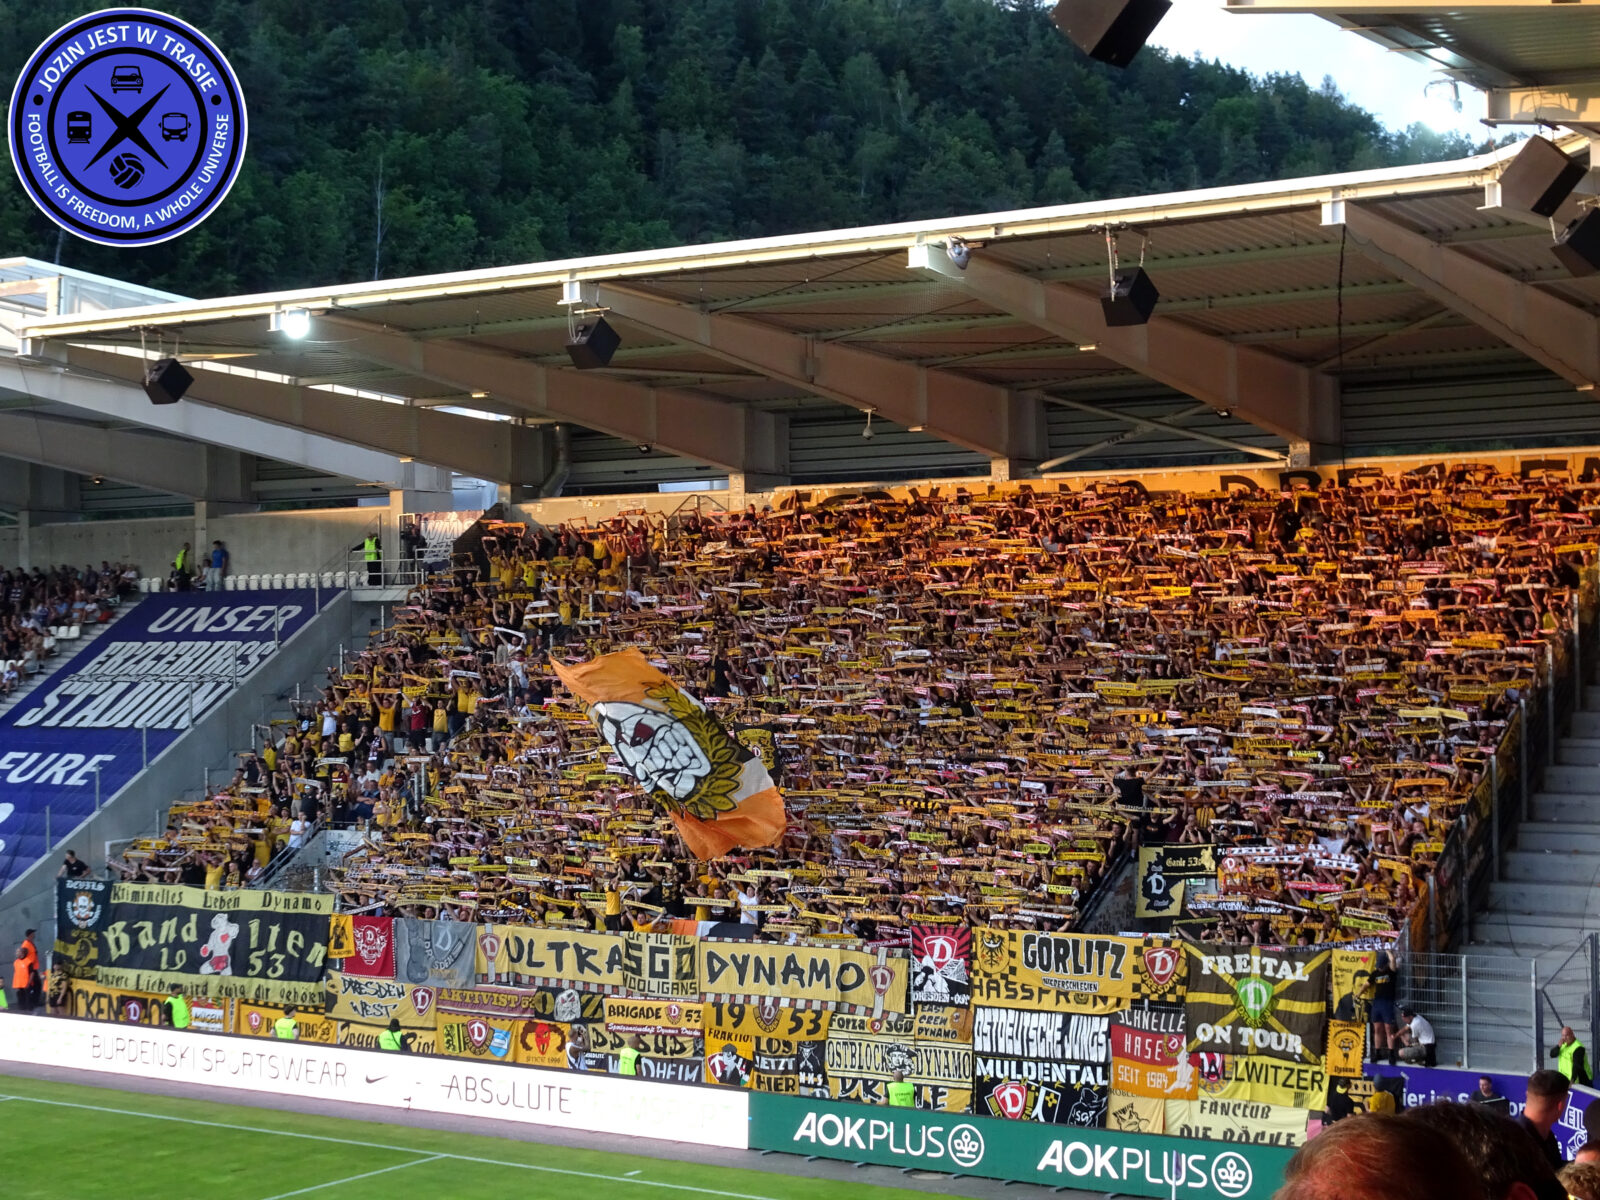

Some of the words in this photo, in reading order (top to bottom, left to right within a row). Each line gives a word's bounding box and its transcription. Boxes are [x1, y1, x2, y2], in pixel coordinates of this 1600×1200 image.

[147, 605, 303, 634] UNSER
[112, 886, 184, 905] Kriminelles
[203, 891, 241, 909] Leben
[262, 891, 323, 911] Dynamo
[160, 948, 187, 971] 19
[247, 949, 286, 979] 53
[1022, 931, 1127, 981] GÖRLITZ
[1200, 953, 1309, 983] FREITAL
[706, 949, 866, 993] DYNAMO
[254, 984, 270, 1000] dir
[341, 975, 407, 1000] DRESDEN
[624, 975, 699, 996] HOOLIGANS
[439, 989, 519, 1008] AKTIVIST
[608, 1004, 662, 1020] BRIGADE
[685, 1009, 702, 1023] 53
[787, 1009, 822, 1035] 53
[831, 1014, 865, 1032] Forza
[918, 1014, 948, 1026] CREW
[1117, 1010, 1186, 1034] SCHNELLE
[917, 1026, 958, 1040] DYNAMO
[974, 1006, 1063, 1060] OSTDEUTSCHE
[1064, 1013, 1109, 1063] JUNGS
[1195, 1022, 1232, 1045] ON
[1237, 1027, 1303, 1054] TOUR
[1124, 1032, 1163, 1061] HASE
[91, 1034, 196, 1070] BURDENSKI
[202, 1046, 347, 1091] SPORTSWEAR
[755, 1055, 795, 1071] JETZT
[827, 1040, 890, 1074] OSTBLOCK
[914, 1048, 973, 1080] DYNAMO
[976, 1057, 1108, 1086] MULDENTAL
[756, 1074, 796, 1093] HIER
[1117, 1064, 1140, 1085] SEIT
[1146, 1071, 1168, 1089] 1984
[446, 1074, 573, 1114] ABSOLUTE
[1199, 1099, 1272, 1120] FANCLUB
